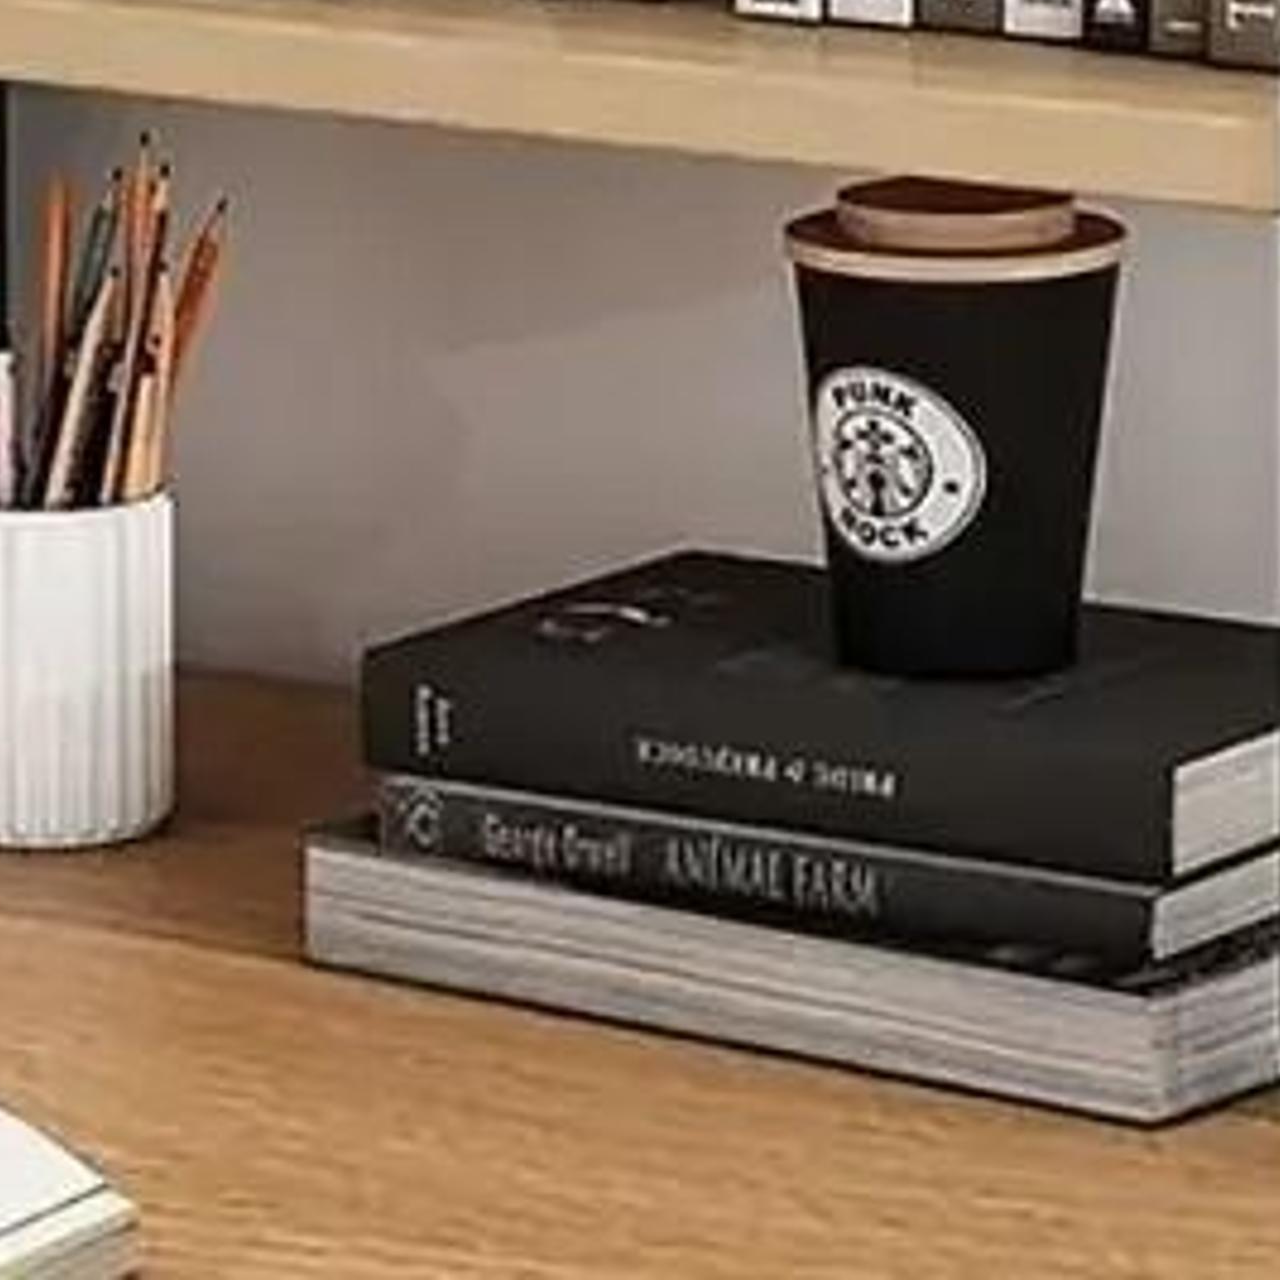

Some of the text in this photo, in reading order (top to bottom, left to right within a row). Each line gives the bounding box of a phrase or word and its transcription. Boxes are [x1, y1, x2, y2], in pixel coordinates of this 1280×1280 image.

[831, 380, 917, 419] PUNK
[665, 834, 784, 901] ANIMAL
[792, 852, 880, 916] FARM
